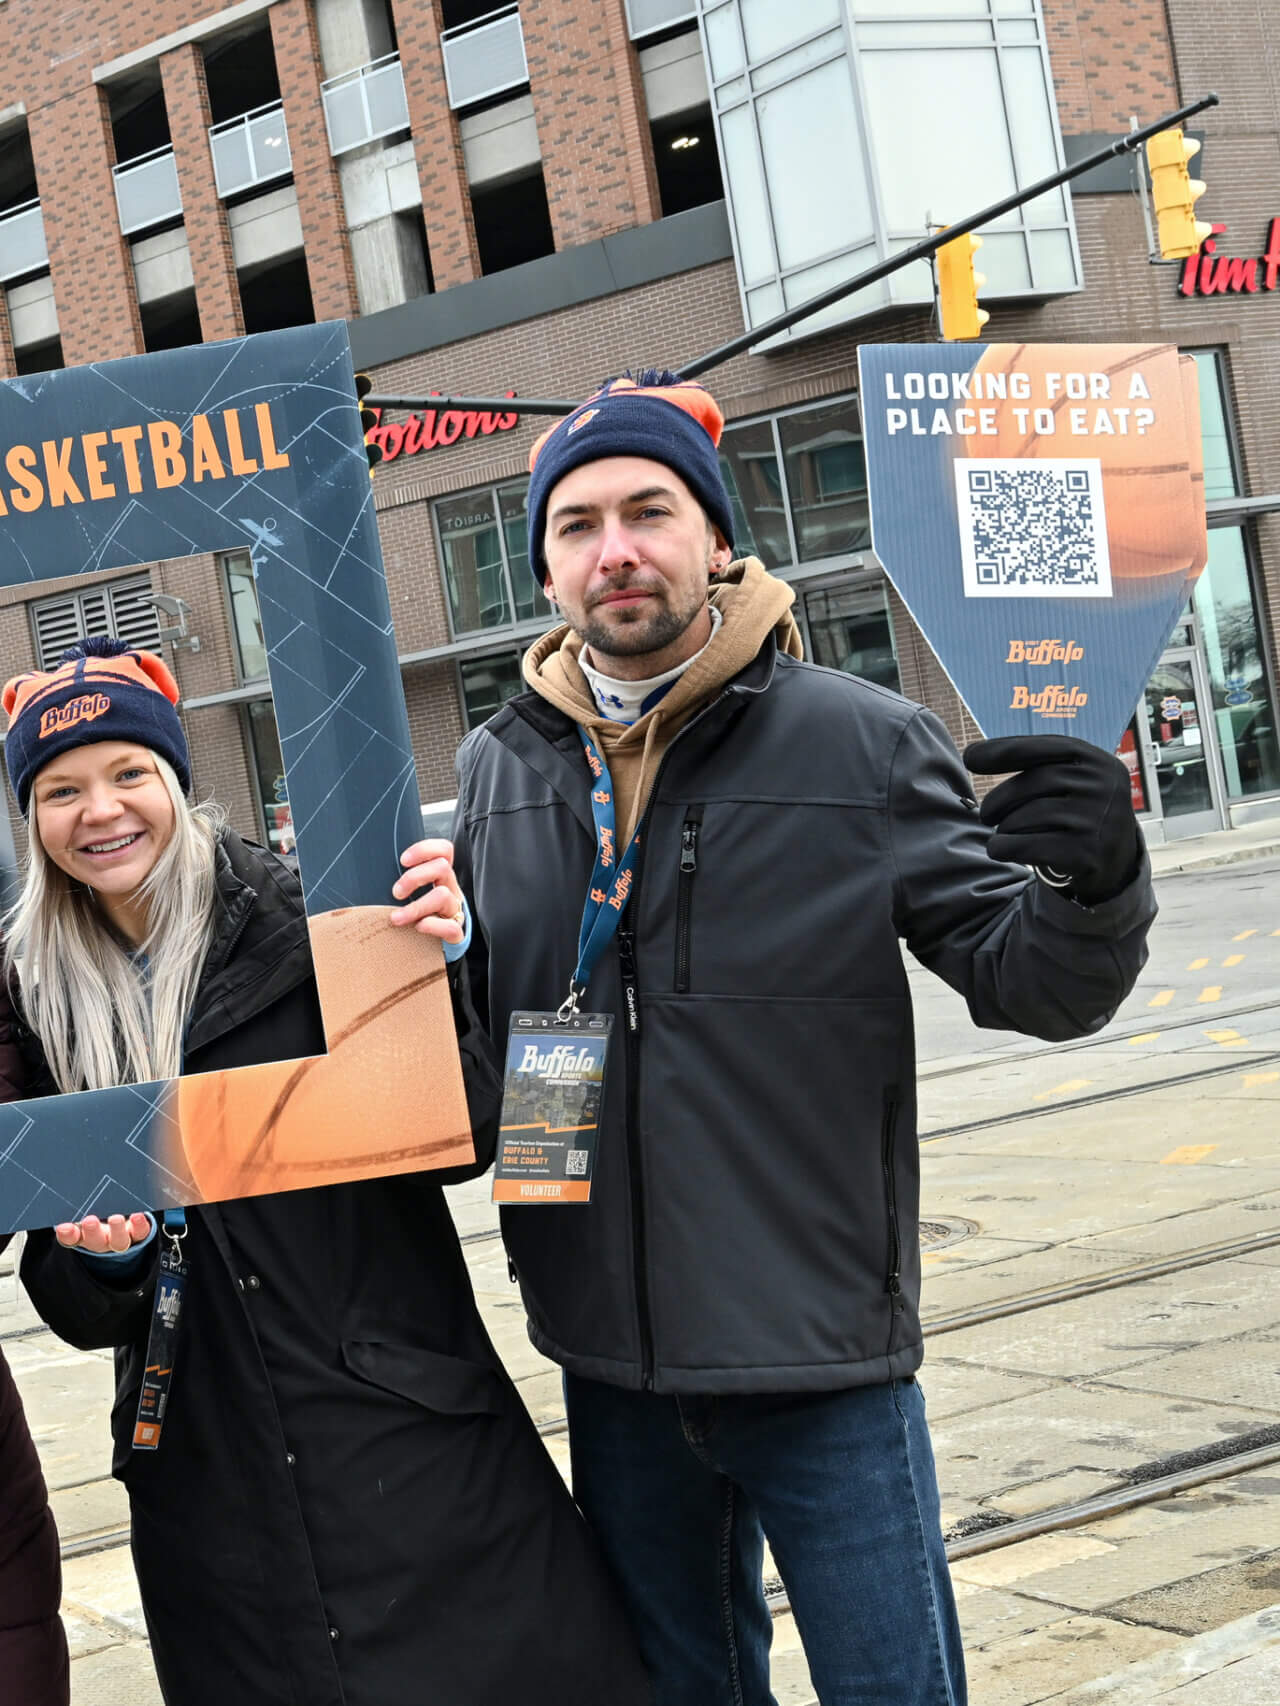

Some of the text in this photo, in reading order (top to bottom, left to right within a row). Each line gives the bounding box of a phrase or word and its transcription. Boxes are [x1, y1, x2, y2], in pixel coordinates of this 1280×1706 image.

[1182, 223, 1258, 296] Tim
[885, 372, 1151, 401] LOOKING FOR A
[365, 390, 518, 461] ortons
[887, 408, 1155, 436] PLACE TO EAT?
[1006, 640, 1085, 666] Buffalo
[1010, 685, 1088, 713] Buffalo
[39, 692, 111, 740] Buffalo
[599, 826, 614, 868] Buffalo
[609, 868, 633, 911] Buffalo
[626, 987, 637, 1030] Calvin Klein
[517, 1045, 595, 1079] Buffalo
[503, 1146, 536, 1154] BUFFALO
[520, 1157, 549, 1165] COUNTY
[520, 1184, 562, 1197] VOLUNTEER
